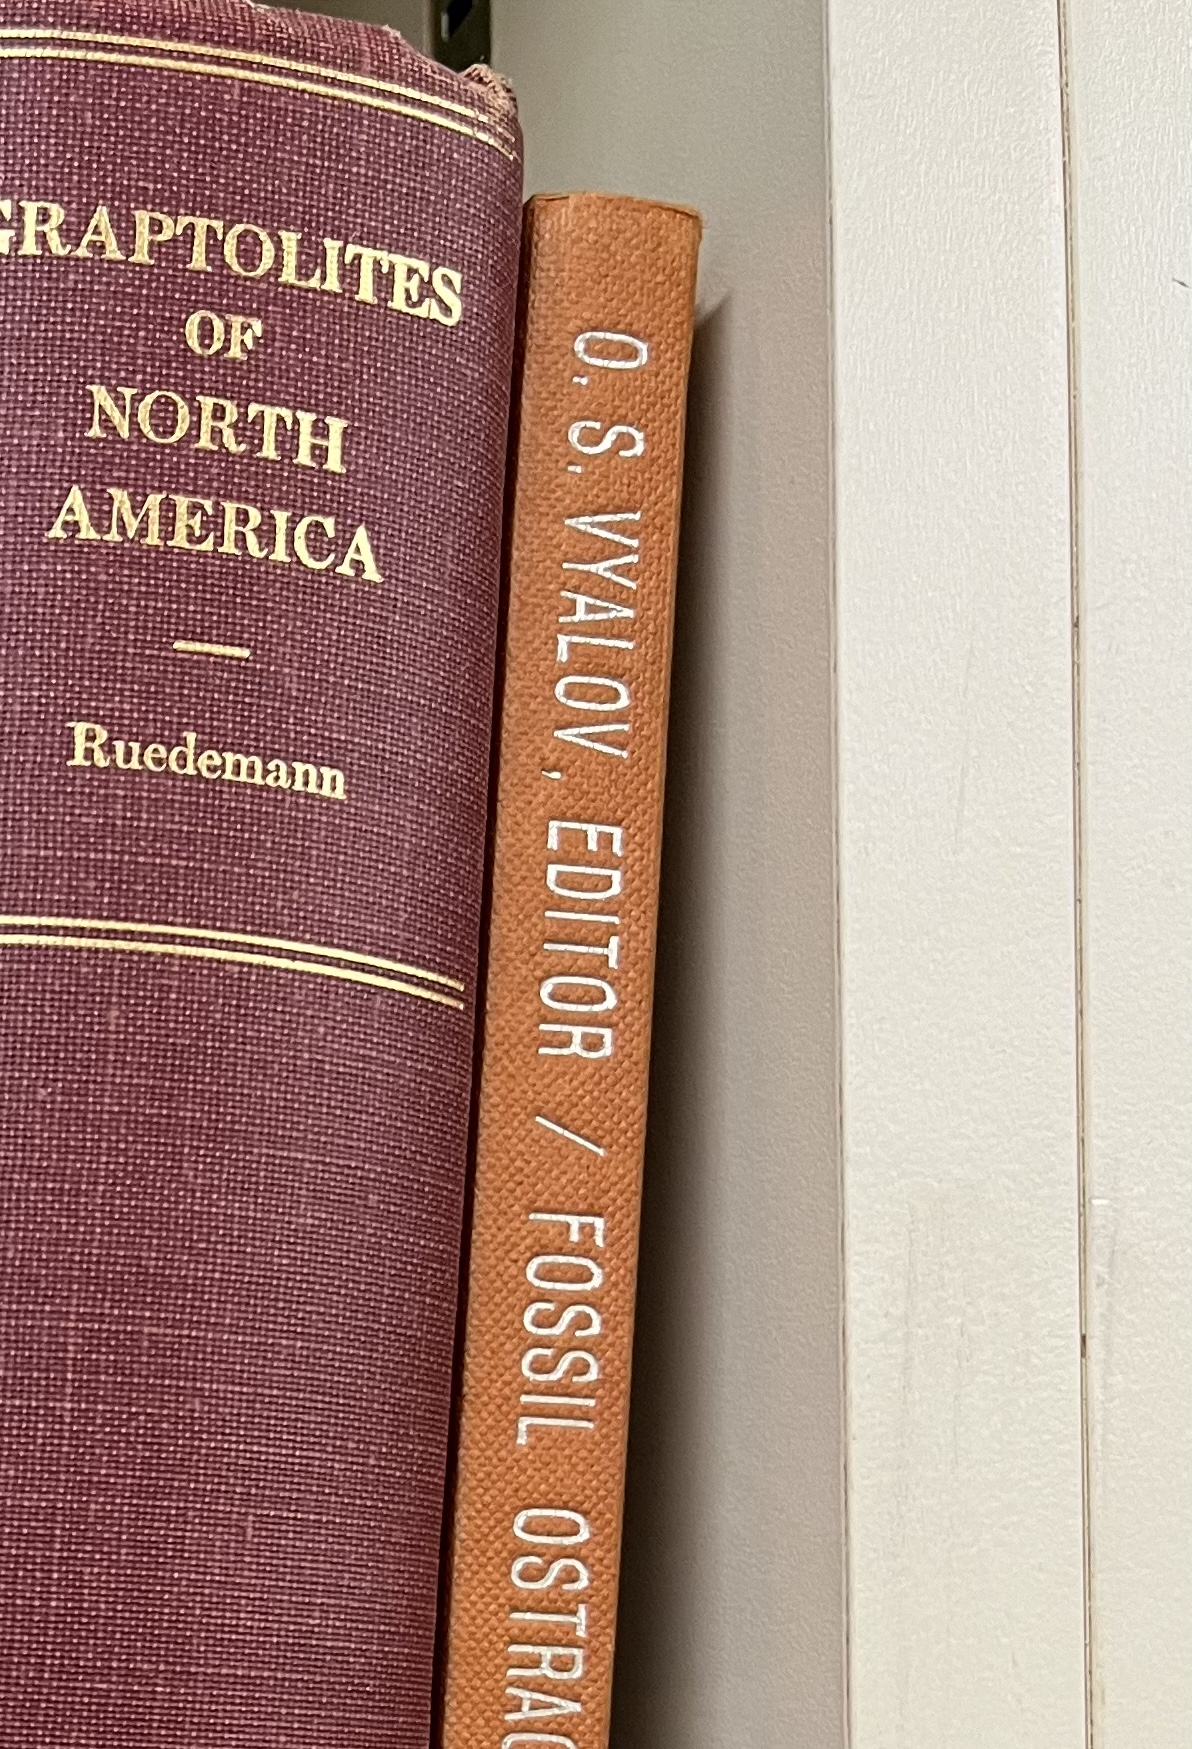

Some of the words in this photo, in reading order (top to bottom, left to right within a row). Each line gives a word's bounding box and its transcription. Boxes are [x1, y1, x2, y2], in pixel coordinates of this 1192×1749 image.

[184, 309, 263, 361] OF
[571, 329, 649, 386] O.
[85, 384, 349, 473] NORTH
[566, 419, 645, 474] S.
[45, 485, 384, 583] AMERICA
[541, 510, 642, 780] VYALOV,
[66, 721, 346, 800] Ruedemann
[537, 818, 624, 1060] EDITOR
[515, 1211, 607, 1446] FOSSIL
